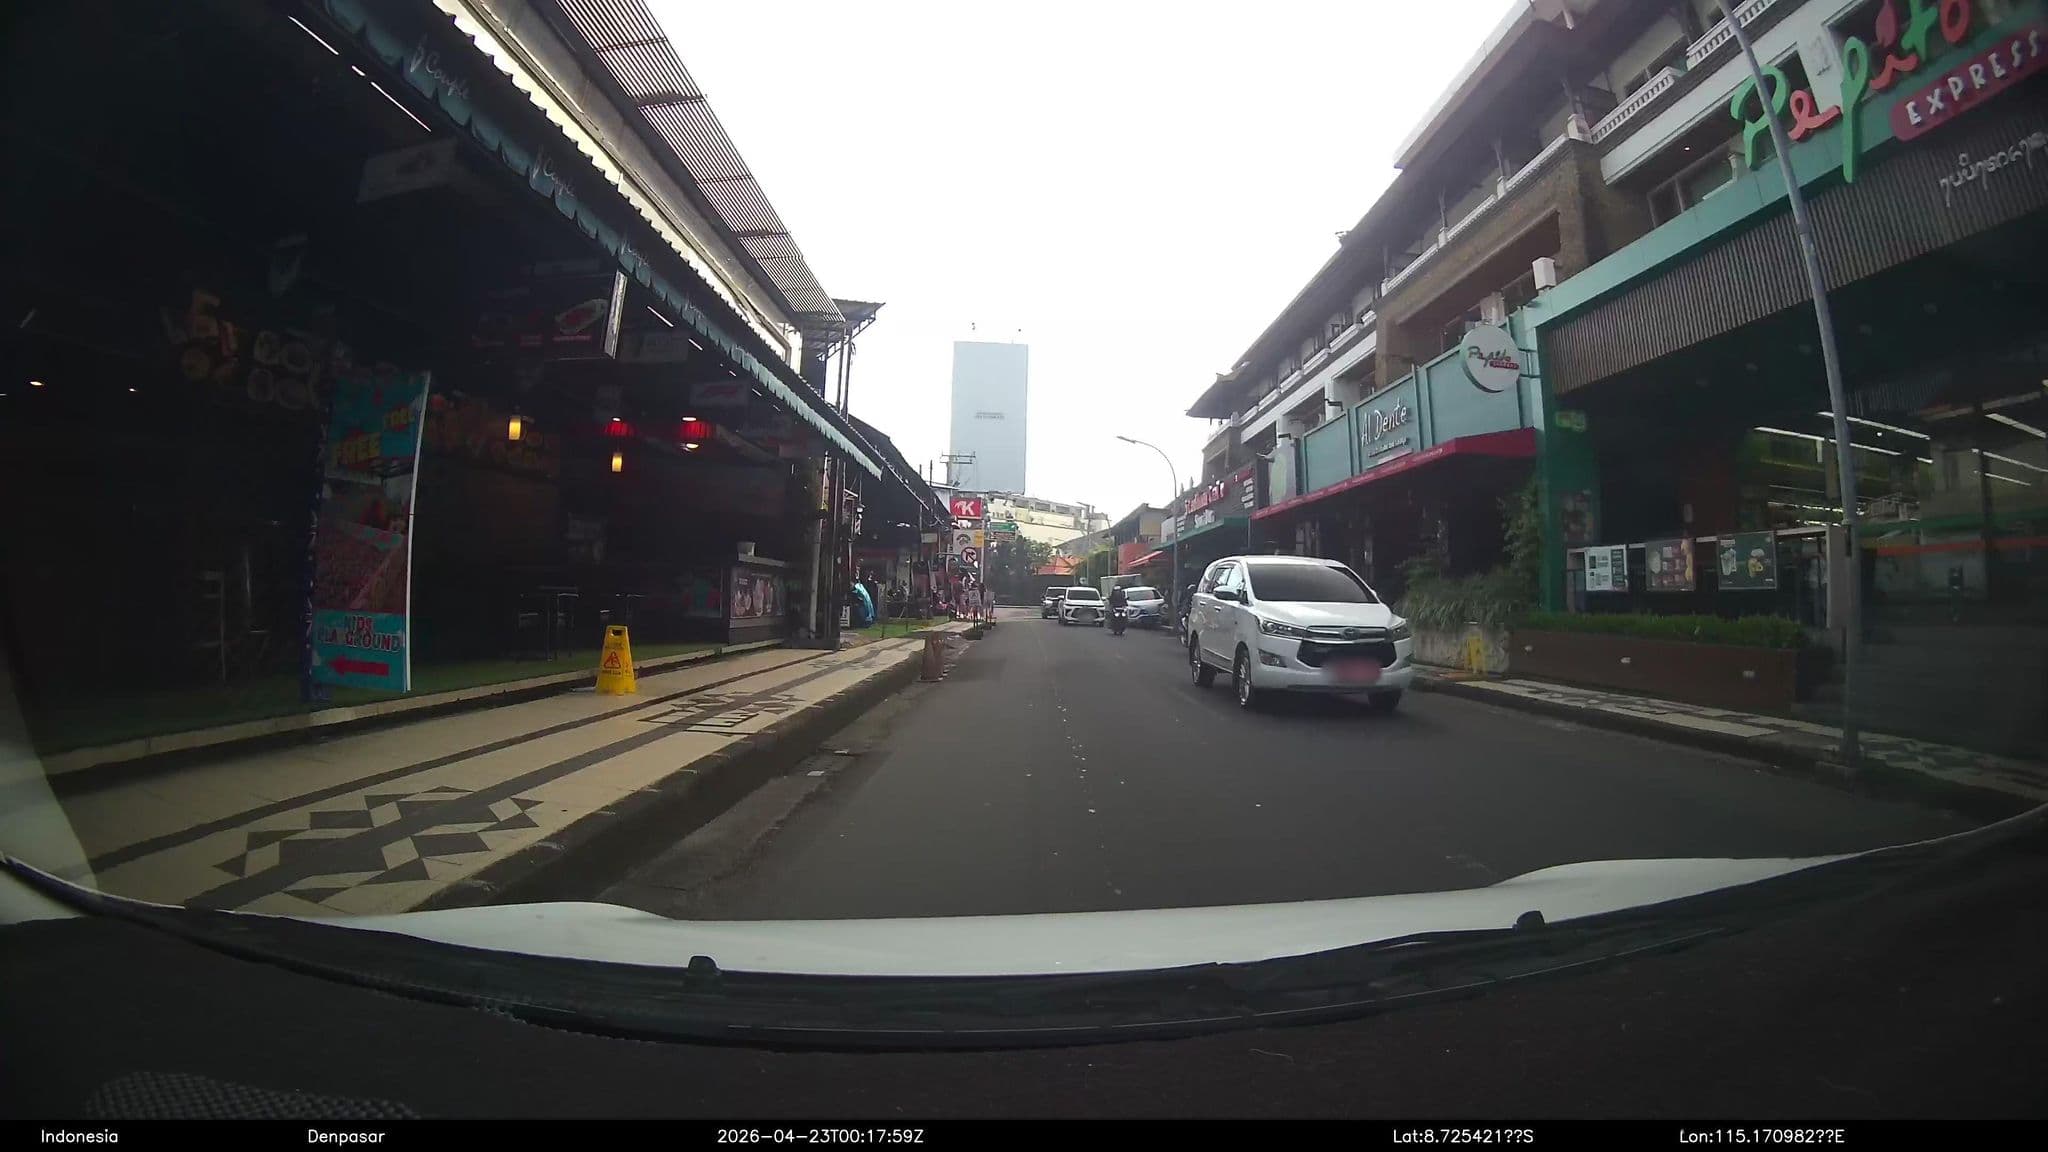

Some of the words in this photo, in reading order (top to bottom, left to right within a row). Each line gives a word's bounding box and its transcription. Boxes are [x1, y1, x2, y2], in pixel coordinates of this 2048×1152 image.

[1730, 0, 1973, 184] Pepito
[1905, 28, 2039, 127] EXPRESS
[1361, 411, 1371, 449] Al
[1374, 397, 1407, 441] Dente
[318, 627, 404, 653] PLAGROUND
